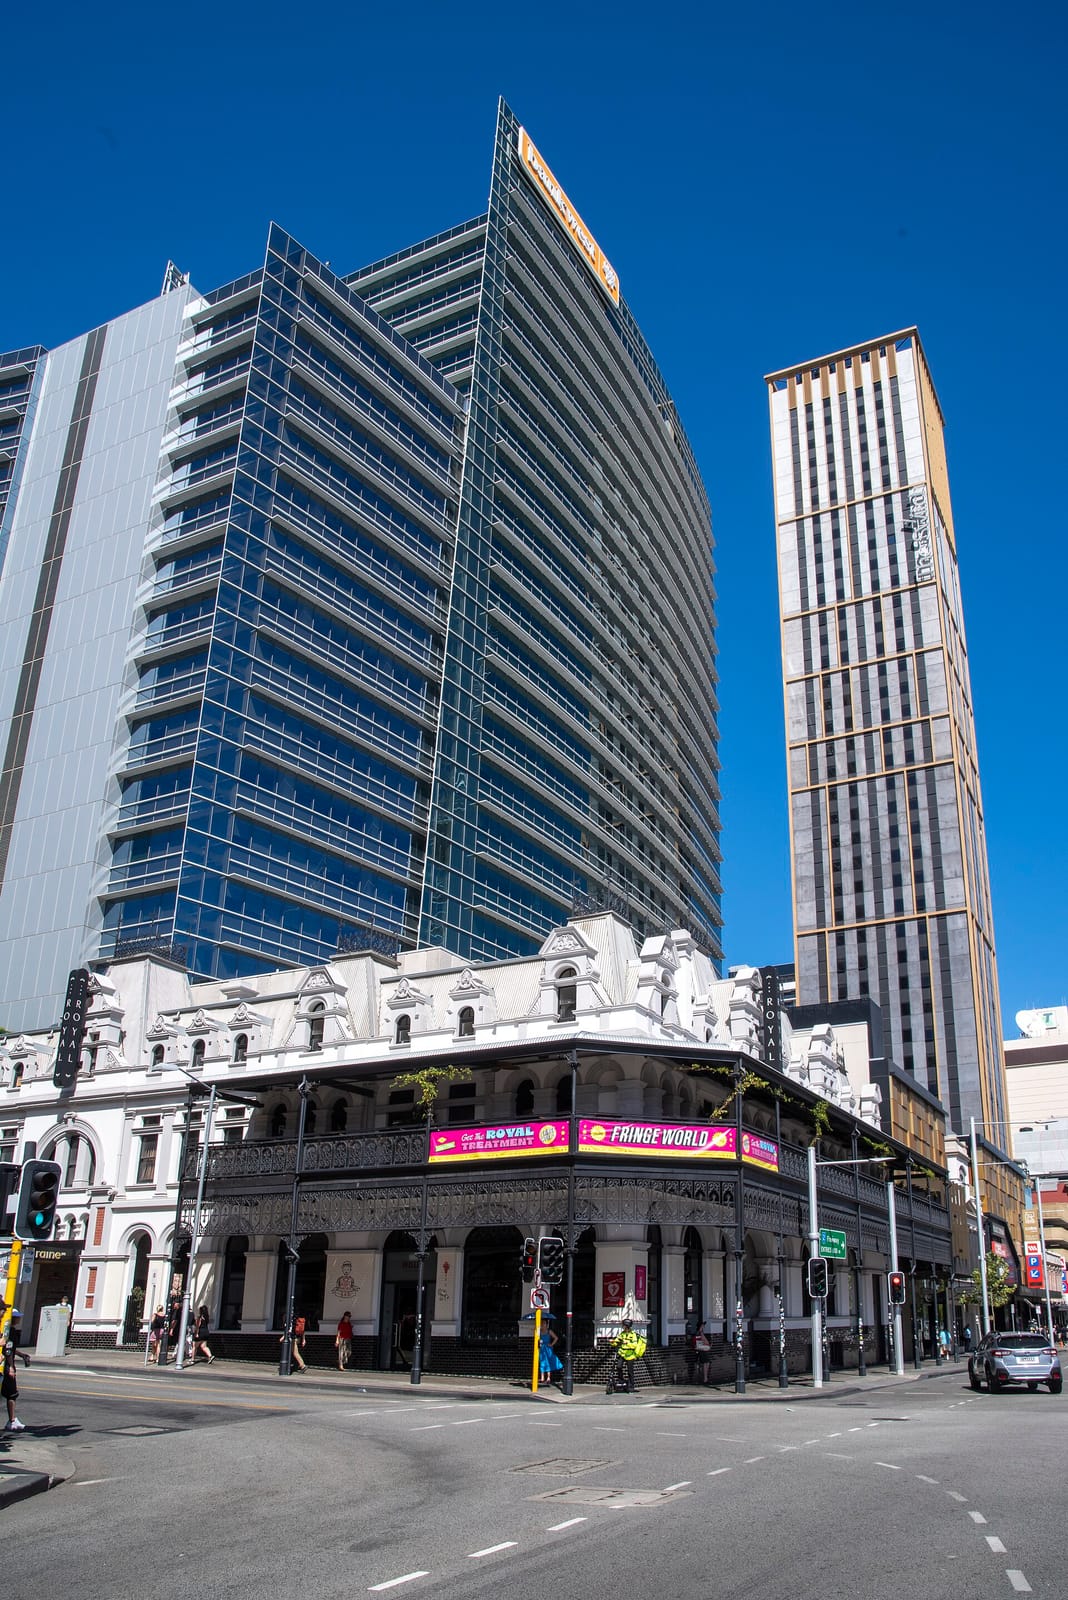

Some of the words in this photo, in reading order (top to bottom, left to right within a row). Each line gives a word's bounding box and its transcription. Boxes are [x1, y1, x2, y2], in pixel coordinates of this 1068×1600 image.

[527, 143, 596, 264] bankwest
[58, 999, 71, 1062] ROYAL
[68, 999, 81, 1063] ROYAL
[766, 997, 775, 1061] ROYAL
[486, 1126, 534, 1140] ROYAL
[610, 1126, 661, 1145] FRINGE
[661, 1129, 709, 1147] WORLD
[461, 1137, 534, 1151] TREATMENT
[35, 1249, 61, 1260] raine
[1030, 1257, 1037, 1266] P
